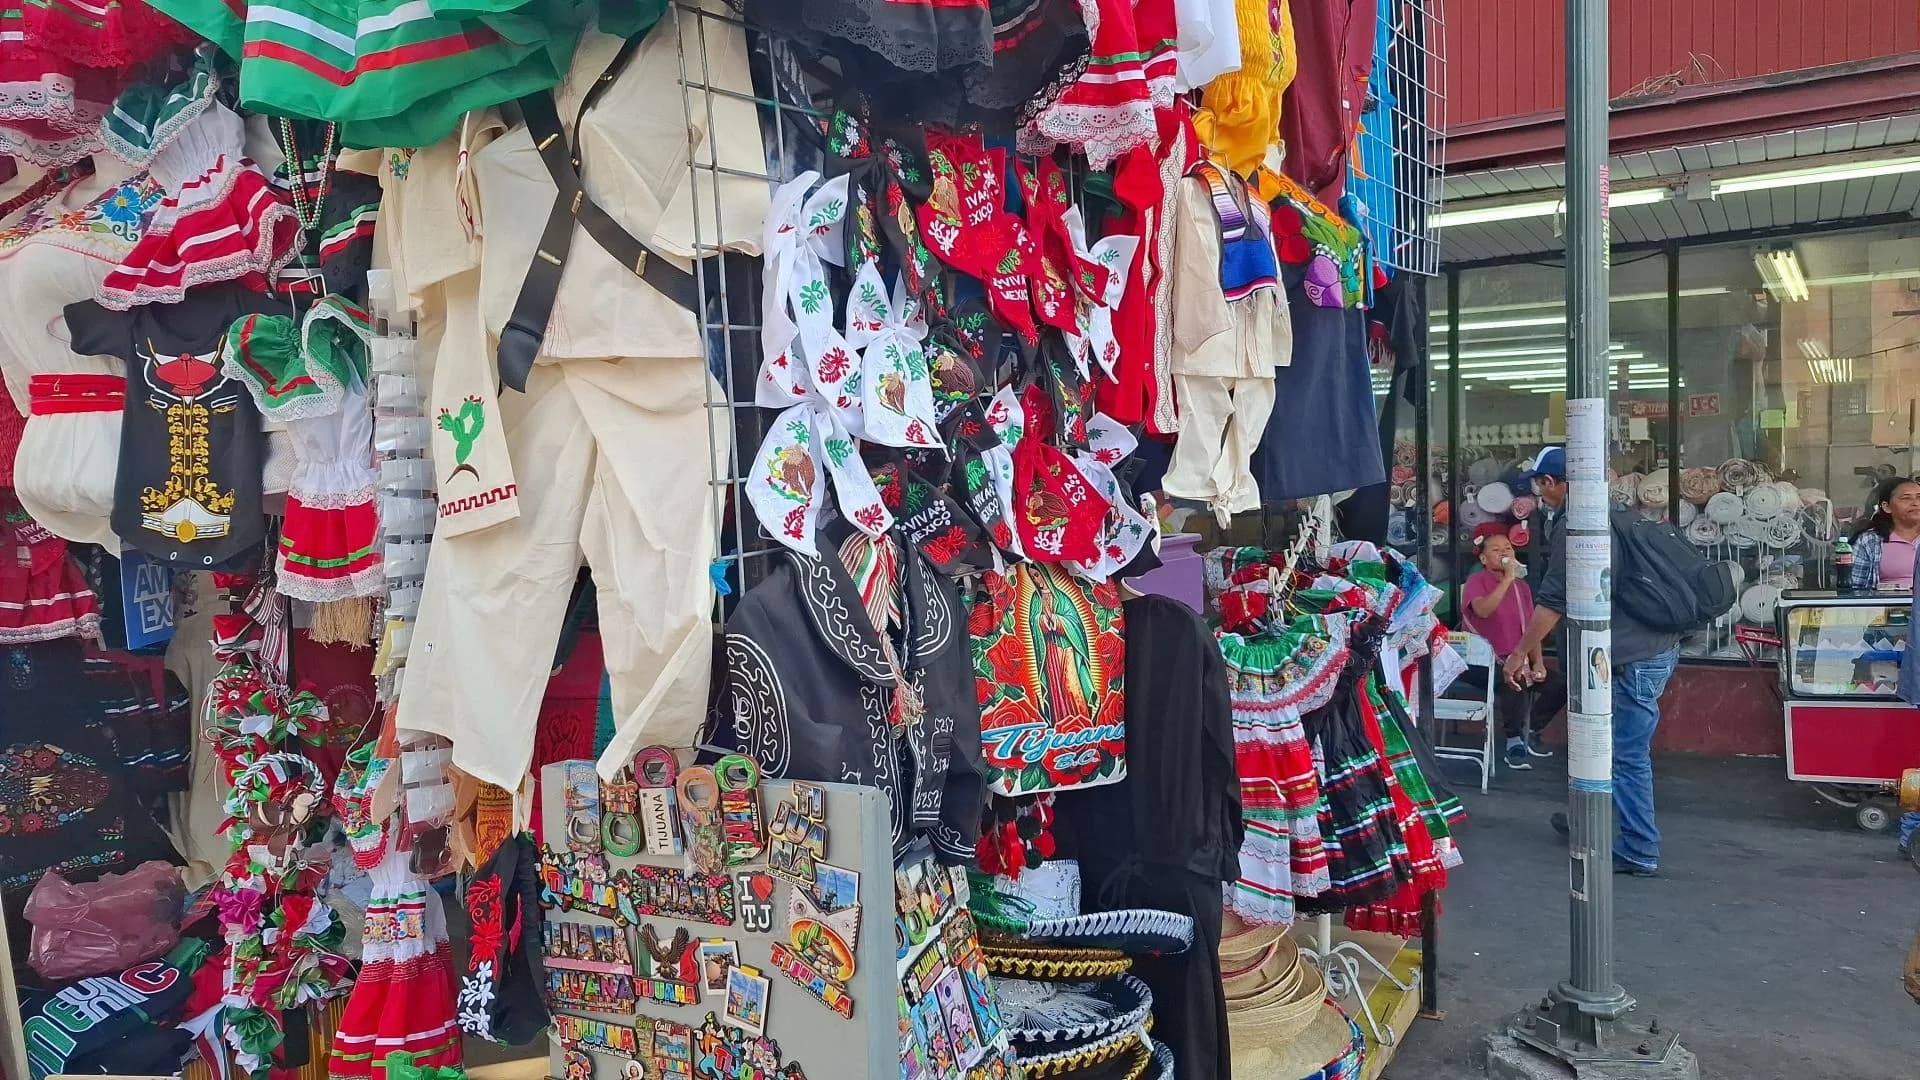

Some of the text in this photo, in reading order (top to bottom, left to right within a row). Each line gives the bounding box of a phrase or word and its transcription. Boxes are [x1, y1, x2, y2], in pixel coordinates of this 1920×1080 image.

[905, 506, 939, 531] VIVA
[981, 722, 1125, 764] Tijuana
[1053, 749, 1098, 770] B.C.
[653, 793, 669, 850] TIJUANA
[739, 876, 753, 900] I
[743, 904, 771, 929] TJ
[23, 962, 180, 1079] MEXIC
[556, 1014, 636, 1053] TIJUANA
